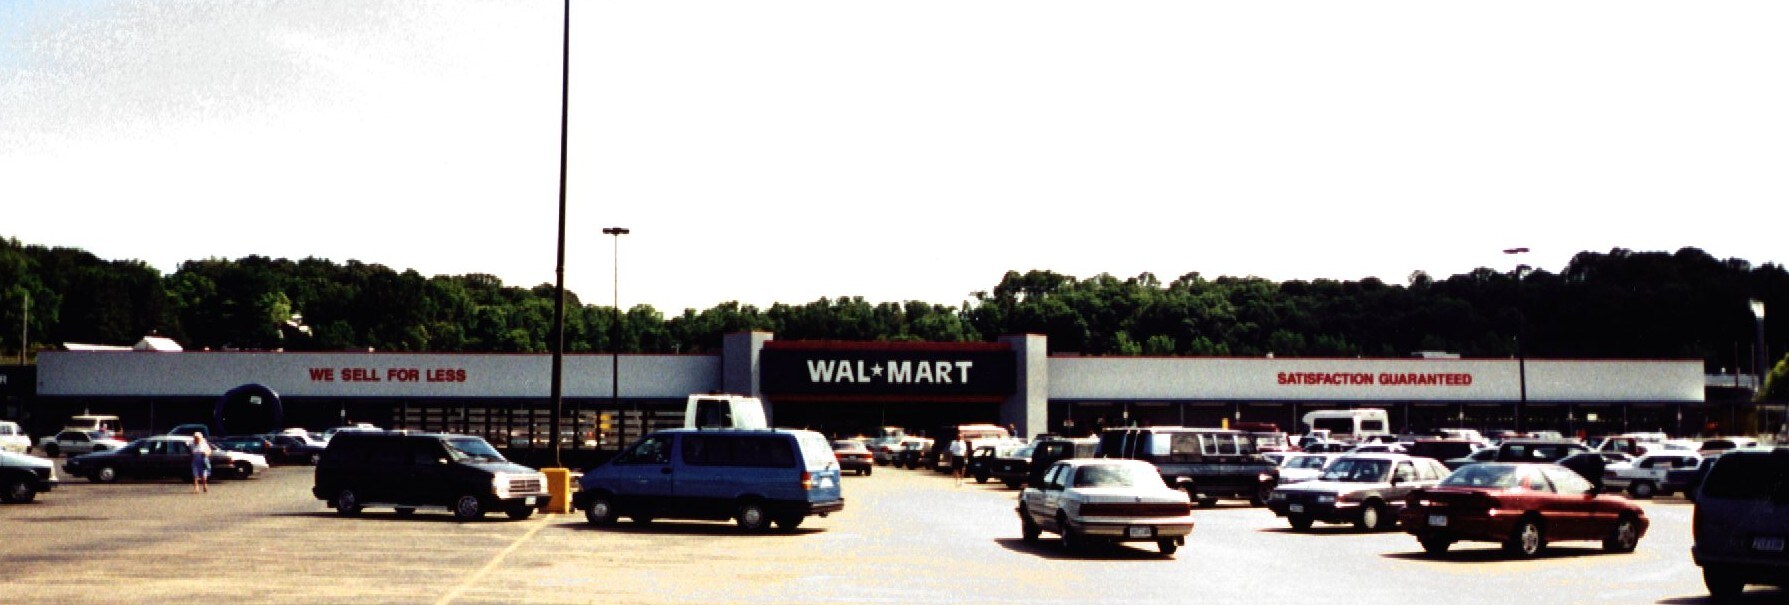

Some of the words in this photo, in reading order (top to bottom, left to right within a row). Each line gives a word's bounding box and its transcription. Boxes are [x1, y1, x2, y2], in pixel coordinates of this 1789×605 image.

[309, 368, 334, 382] WE
[341, 368, 381, 382] SELL
[387, 368, 420, 382] FOR
[426, 368, 467, 383] LESS
[1277, 372, 1374, 386] SATISFACTION
[1378, 372, 1473, 386] GUARANTEED
